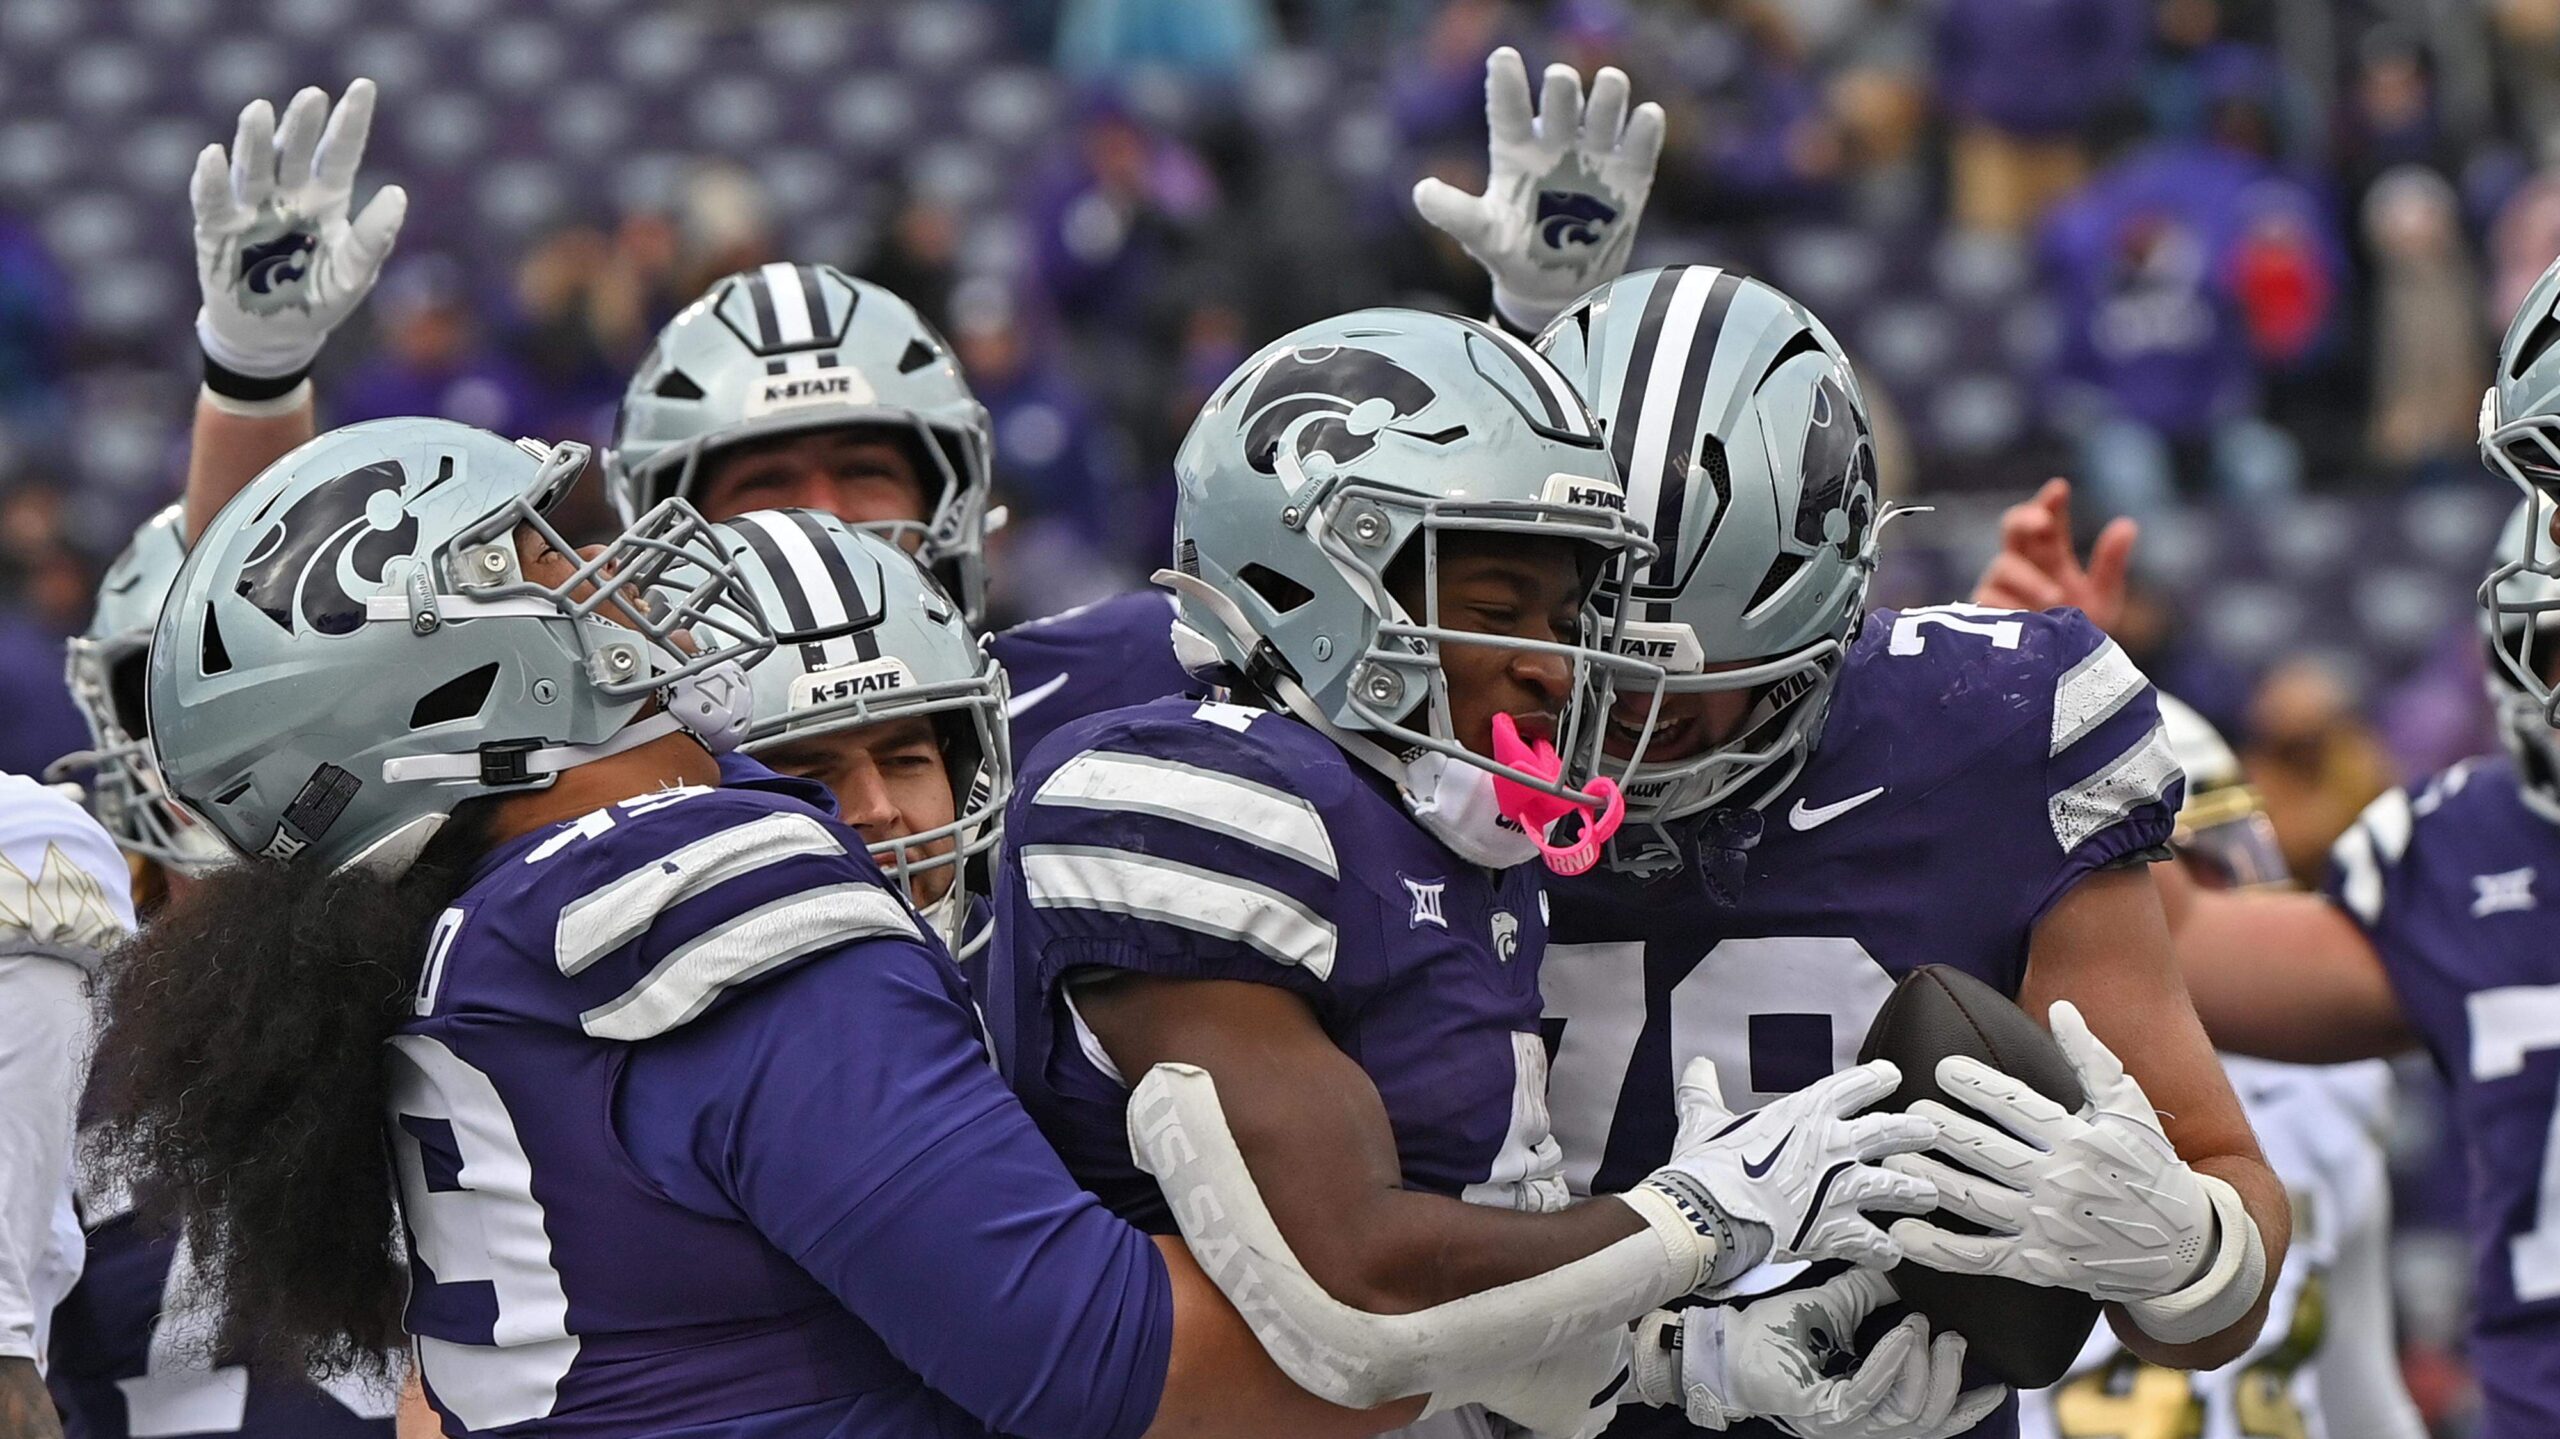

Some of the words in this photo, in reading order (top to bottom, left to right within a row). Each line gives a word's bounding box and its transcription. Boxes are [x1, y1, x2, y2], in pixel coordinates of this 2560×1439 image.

[764, 376, 851, 402] K-STATE
[1567, 486, 1627, 513] K-STATE
[811, 670, 901, 705] K-STATE
